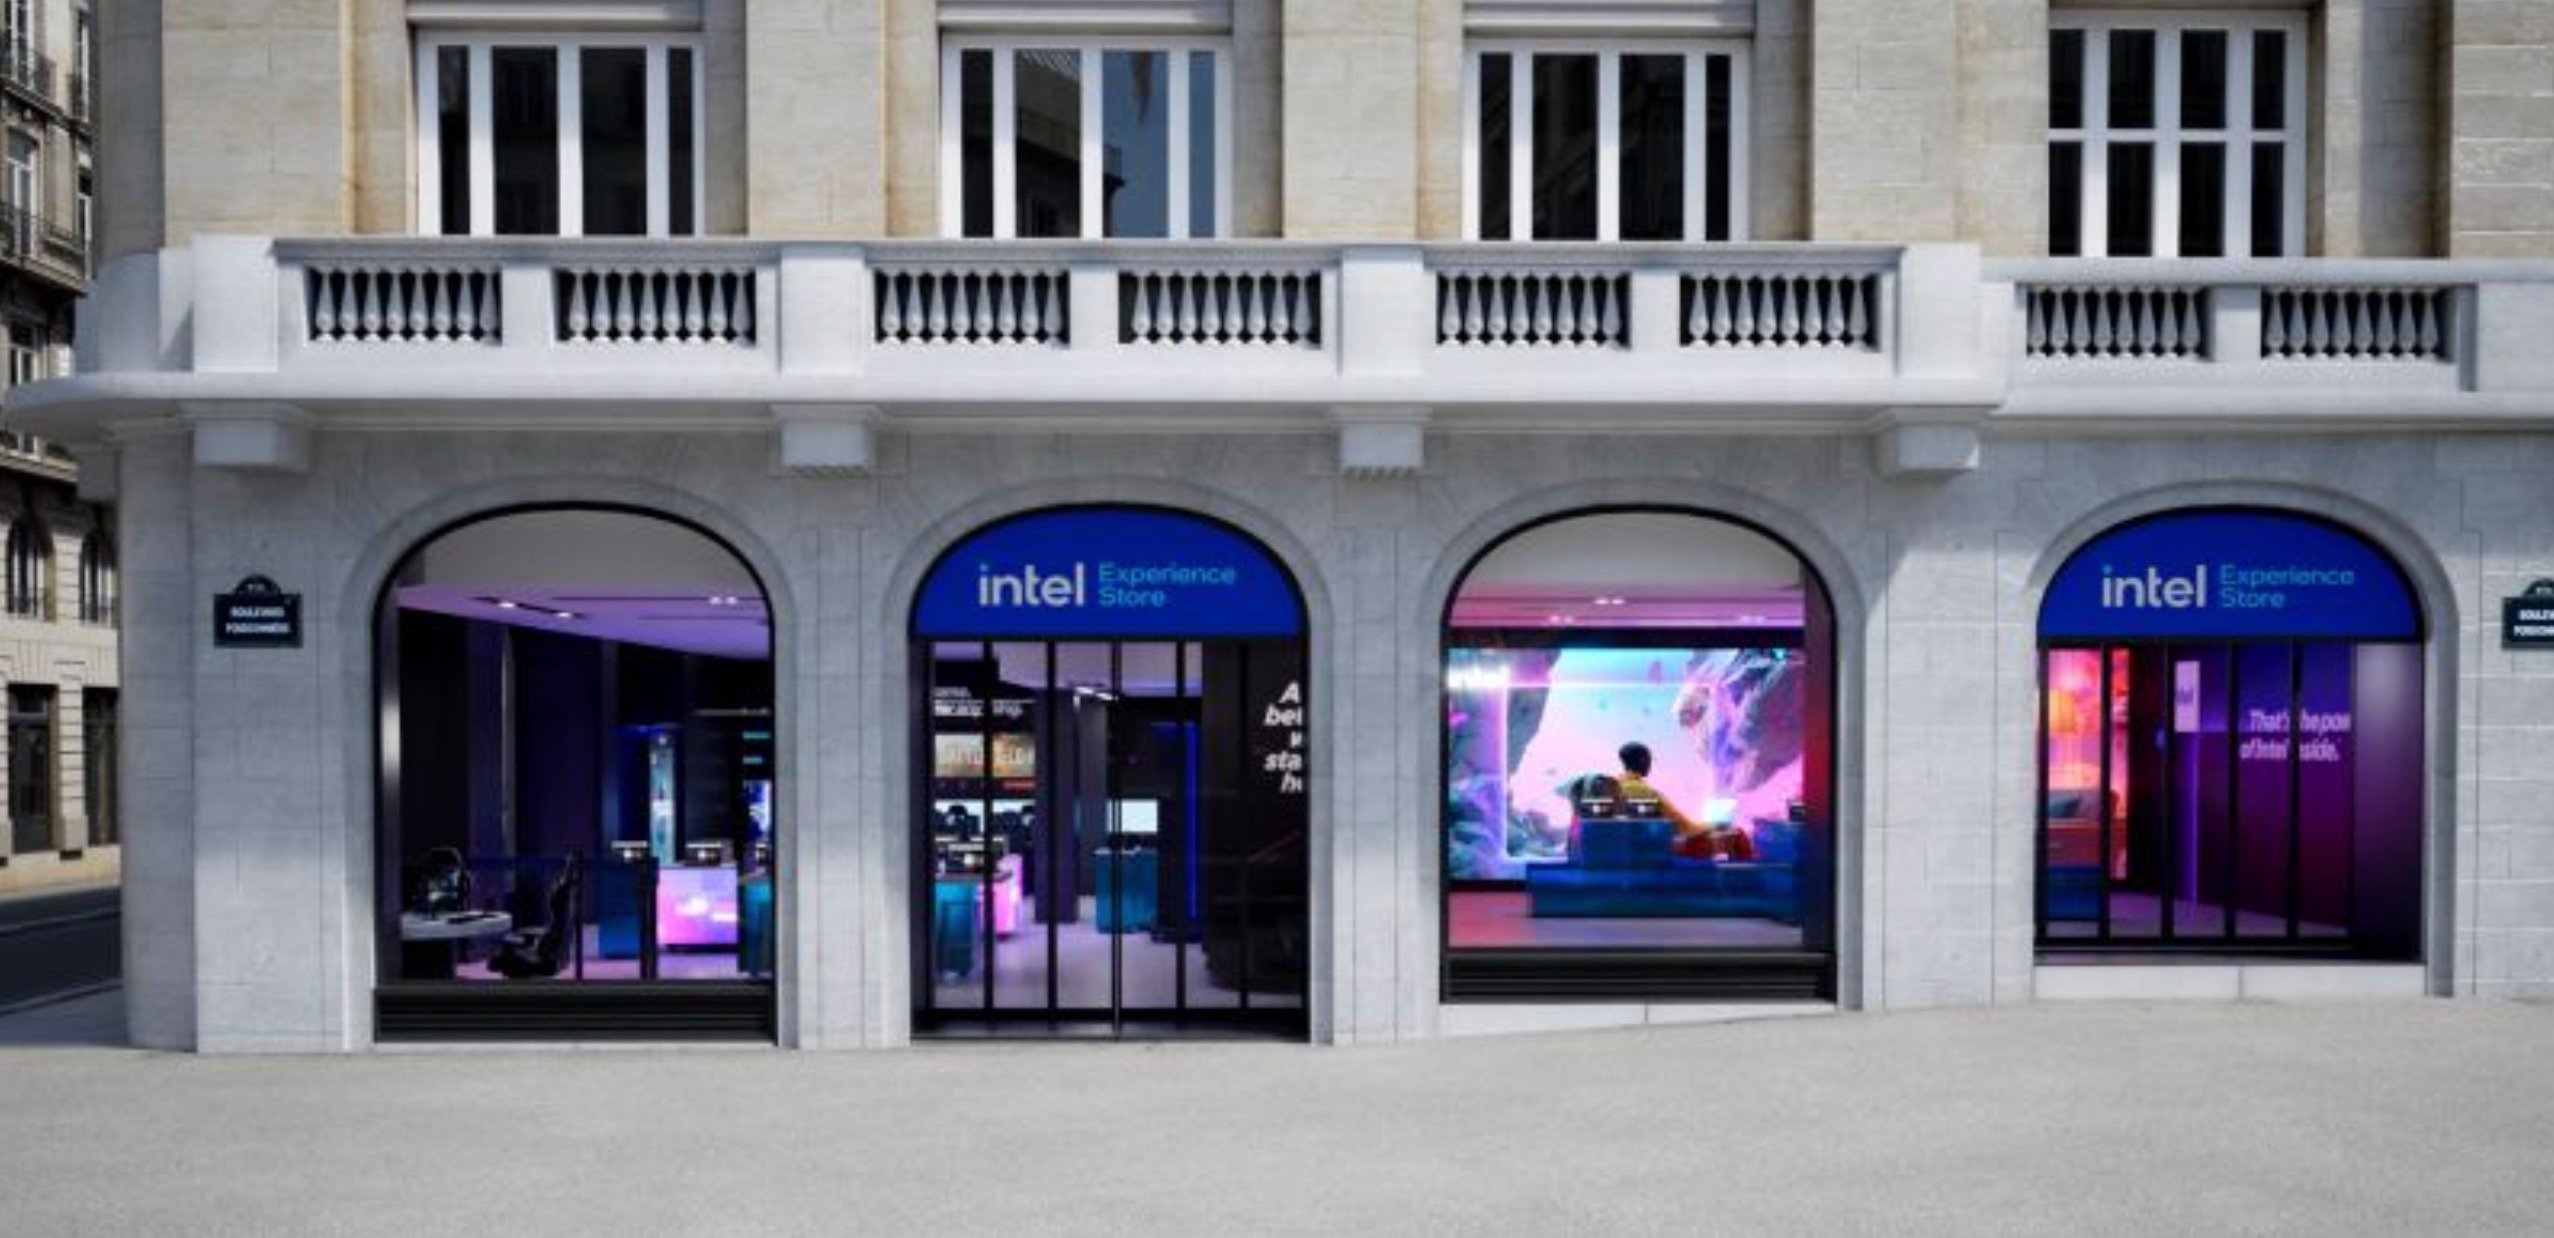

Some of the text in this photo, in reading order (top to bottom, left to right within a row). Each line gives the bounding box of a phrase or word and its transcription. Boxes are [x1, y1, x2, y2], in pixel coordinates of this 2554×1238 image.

[979, 562, 1236, 606] intel Experience
[2102, 564, 2355, 608] intel Experience
[1099, 587, 1166, 607] Store
[2219, 588, 2285, 608] Store
[1278, 682, 1300, 703] A
[2299, 709, 2320, 733] he
